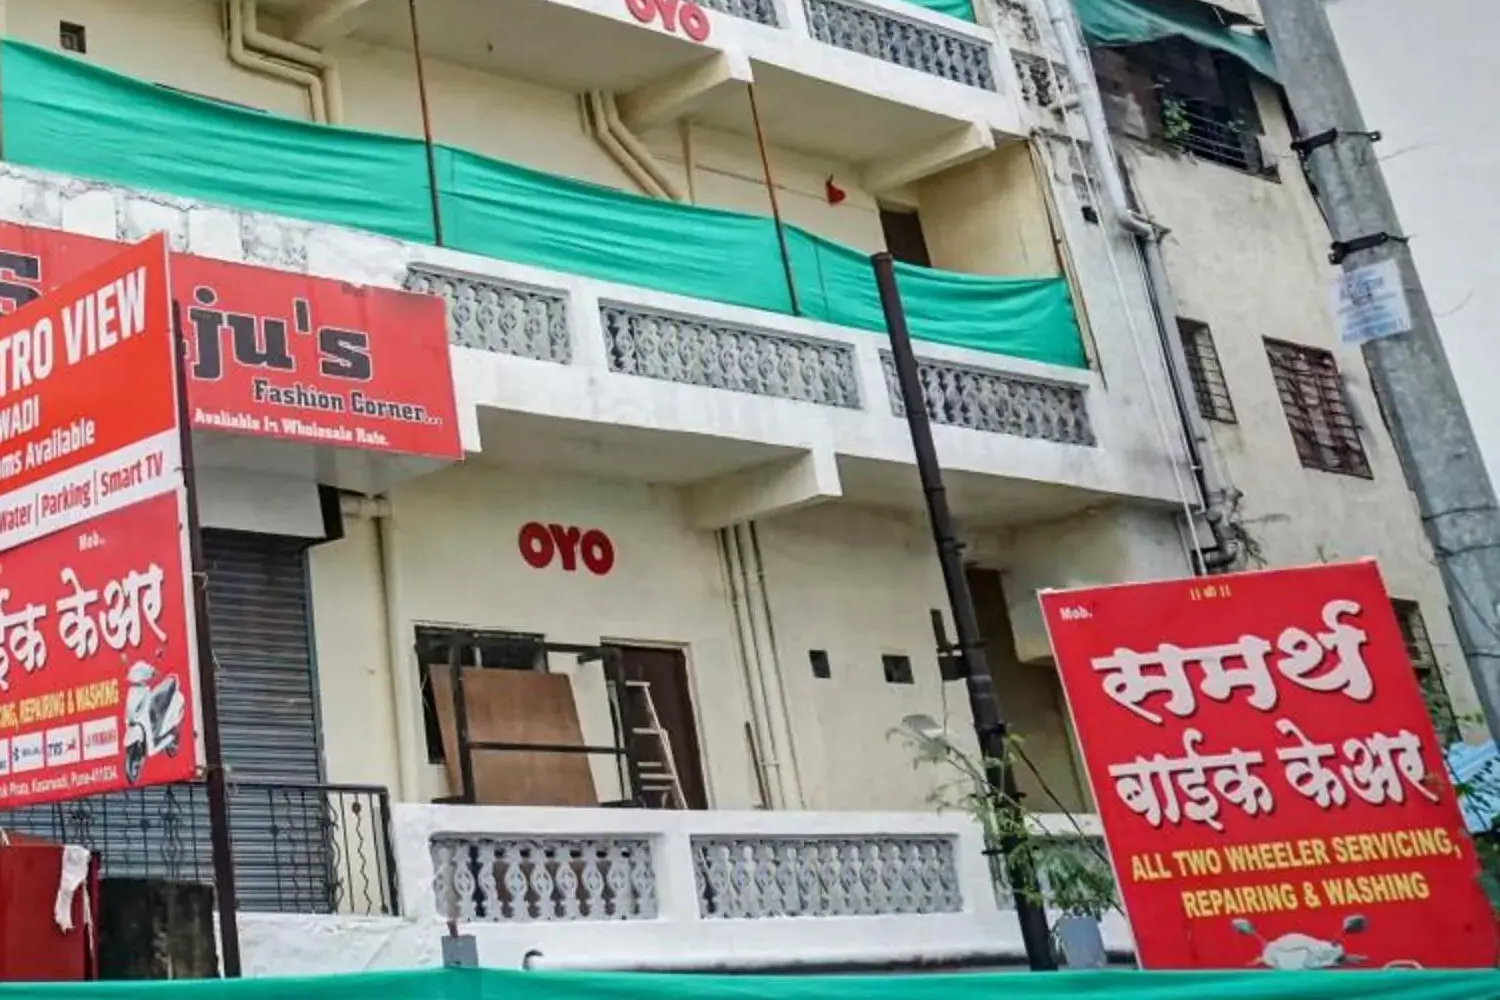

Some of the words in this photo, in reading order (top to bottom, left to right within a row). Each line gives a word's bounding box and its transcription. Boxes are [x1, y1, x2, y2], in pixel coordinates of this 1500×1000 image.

[62, 266, 147, 366] VIEW
[254, 378, 343, 411] Fashion
[25, 419, 96, 469] Available
[194, 408, 260, 431] Available
[282, 418, 353, 442] Wholesale
[41, 481, 91, 518] Parking
[101, 465, 143, 496] Smart
[145, 453, 163, 477] TV
[518, 521, 615, 575] OYO
[57, 562, 167, 658] केअर
[1060, 605, 1092, 621] Mob.
[1091, 599, 1375, 725] समर्थ
[19, 691, 65, 725] REPAIRING
[76, 680, 119, 712] WASHING
[1108, 728, 1274, 831] बाईक
[1276, 719, 1439, 808] केअर
[1131, 854, 1171, 881] ALL
[1173, 849, 1222, 876] TWO
[1225, 841, 1329, 873] WHEELER
[1334, 827, 1462, 861] SERVICING,
[1181, 881, 1299, 918] REPAIRING
[1305, 882, 1321, 908] &
[1324, 872, 1429, 908] WASHING
